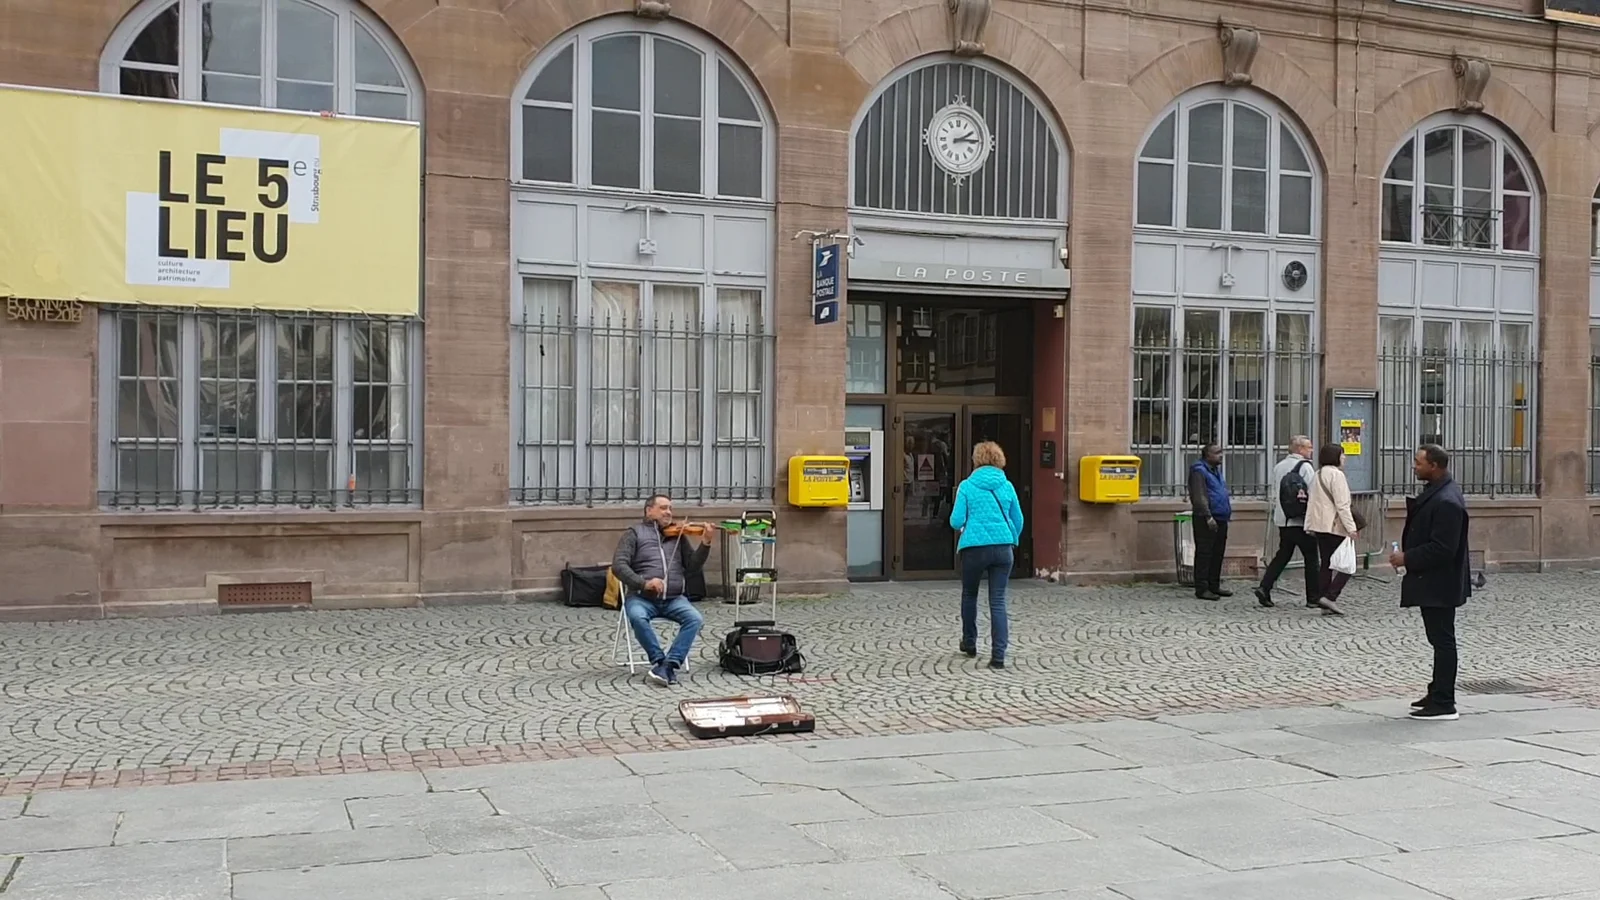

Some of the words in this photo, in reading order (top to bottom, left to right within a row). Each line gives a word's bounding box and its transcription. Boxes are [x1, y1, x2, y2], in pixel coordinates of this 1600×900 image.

[159, 150, 226, 206] LE
[158, 206, 289, 264] LIEU
[157, 267, 201, 275] architecture
[896, 266, 927, 278] LA
[944, 268, 1028, 283] POSTE
[157, 275, 197, 283] patrimoine
[816, 276, 835, 288] BANQUE
[816, 286, 835, 298] POSTALE
